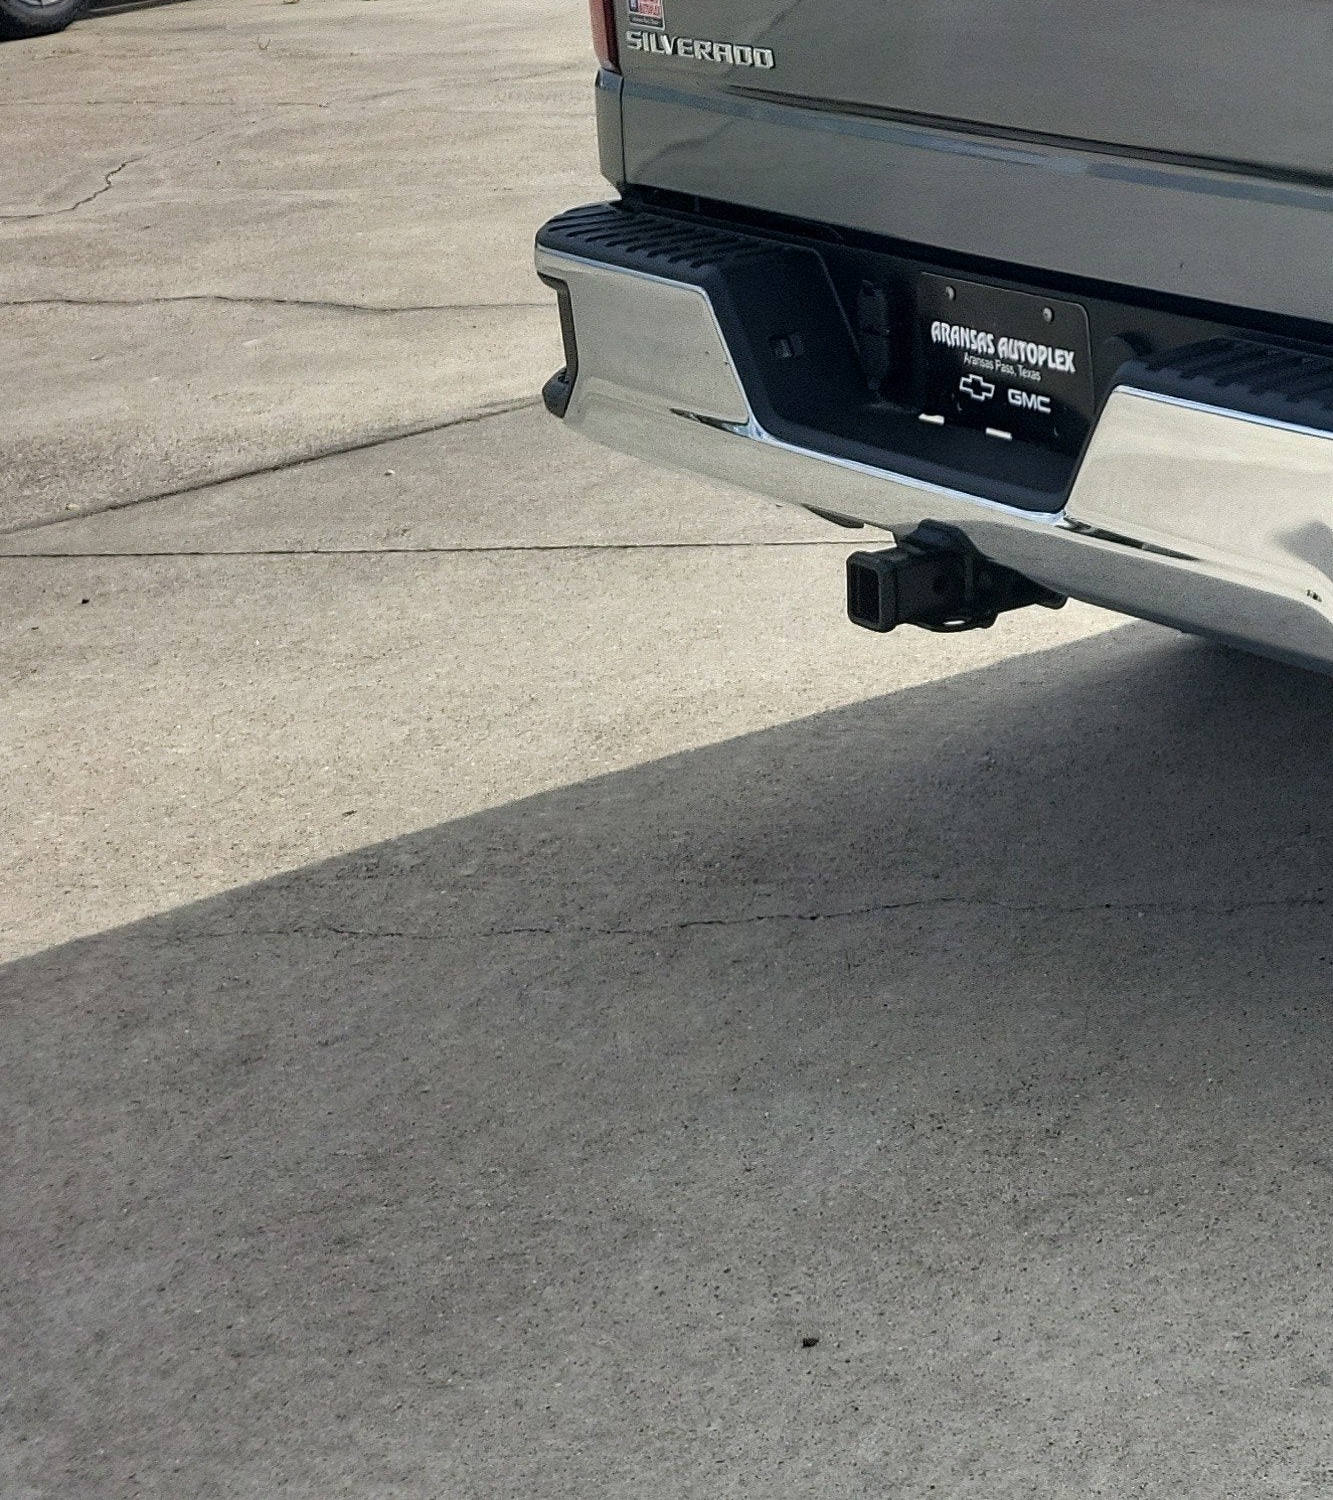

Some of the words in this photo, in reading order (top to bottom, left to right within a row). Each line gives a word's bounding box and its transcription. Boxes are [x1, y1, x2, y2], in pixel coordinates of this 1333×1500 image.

[626, 30, 775, 69] SILVERADO
[930, 320, 995, 354] ARANSAS
[998, 336, 1076, 374] AUTOPLEX
[963, 352, 994, 370] Aransas
[995, 359, 1016, 376] Pass,
[1018, 364, 1042, 382] Texas
[1007, 388, 1052, 414] GMC
